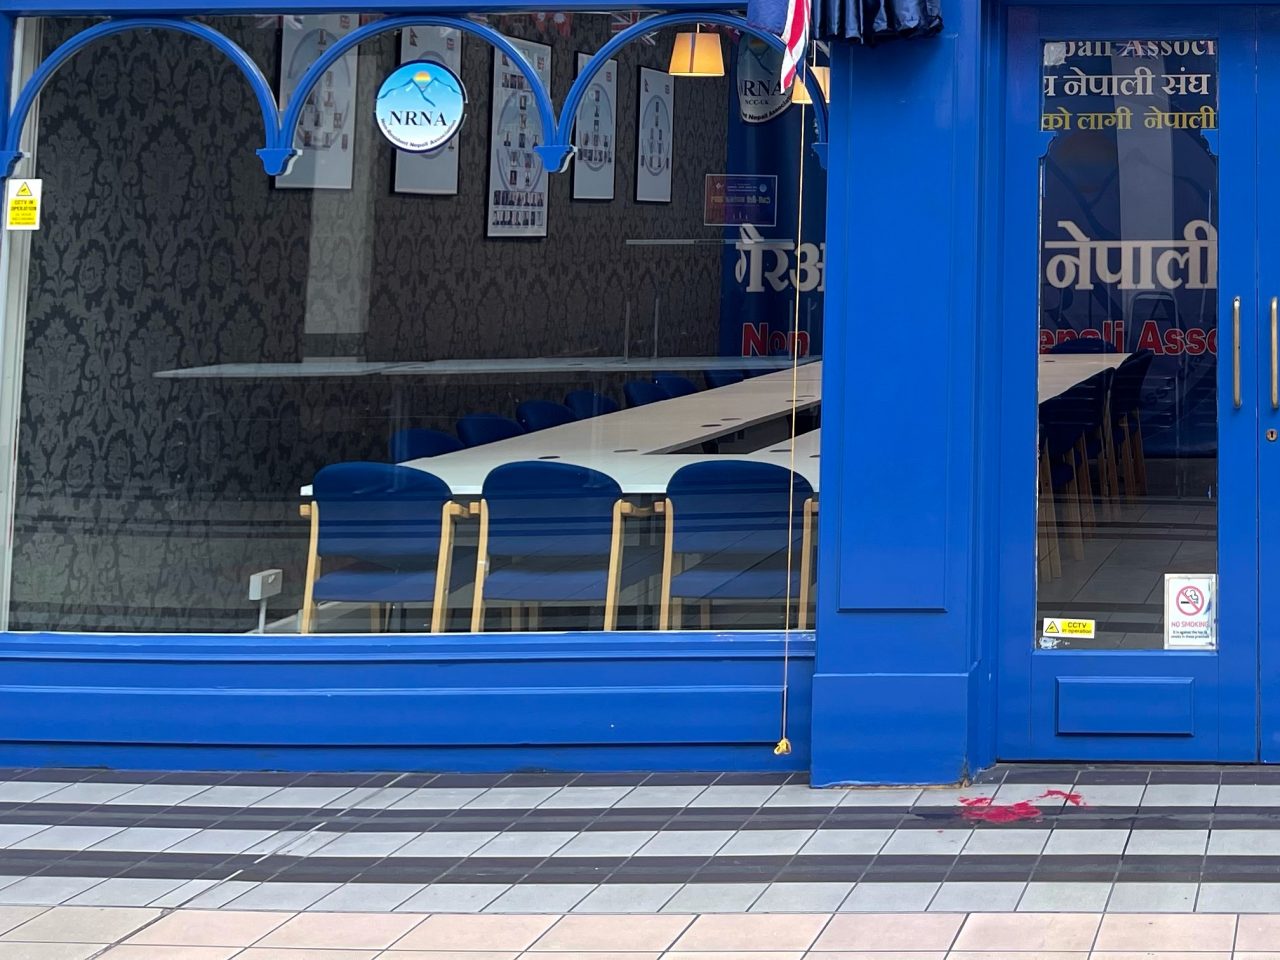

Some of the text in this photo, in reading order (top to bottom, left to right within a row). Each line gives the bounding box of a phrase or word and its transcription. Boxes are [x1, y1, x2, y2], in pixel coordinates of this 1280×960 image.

[1062, 66, 1156, 97] नेपाली
[1160, 66, 1212, 96] संघ
[388, 110, 448, 127] NRNA
[1077, 105, 1134, 130] लागी
[1143, 105, 1217, 130] नेपाली
[1045, 218, 1218, 291] नेपाली
